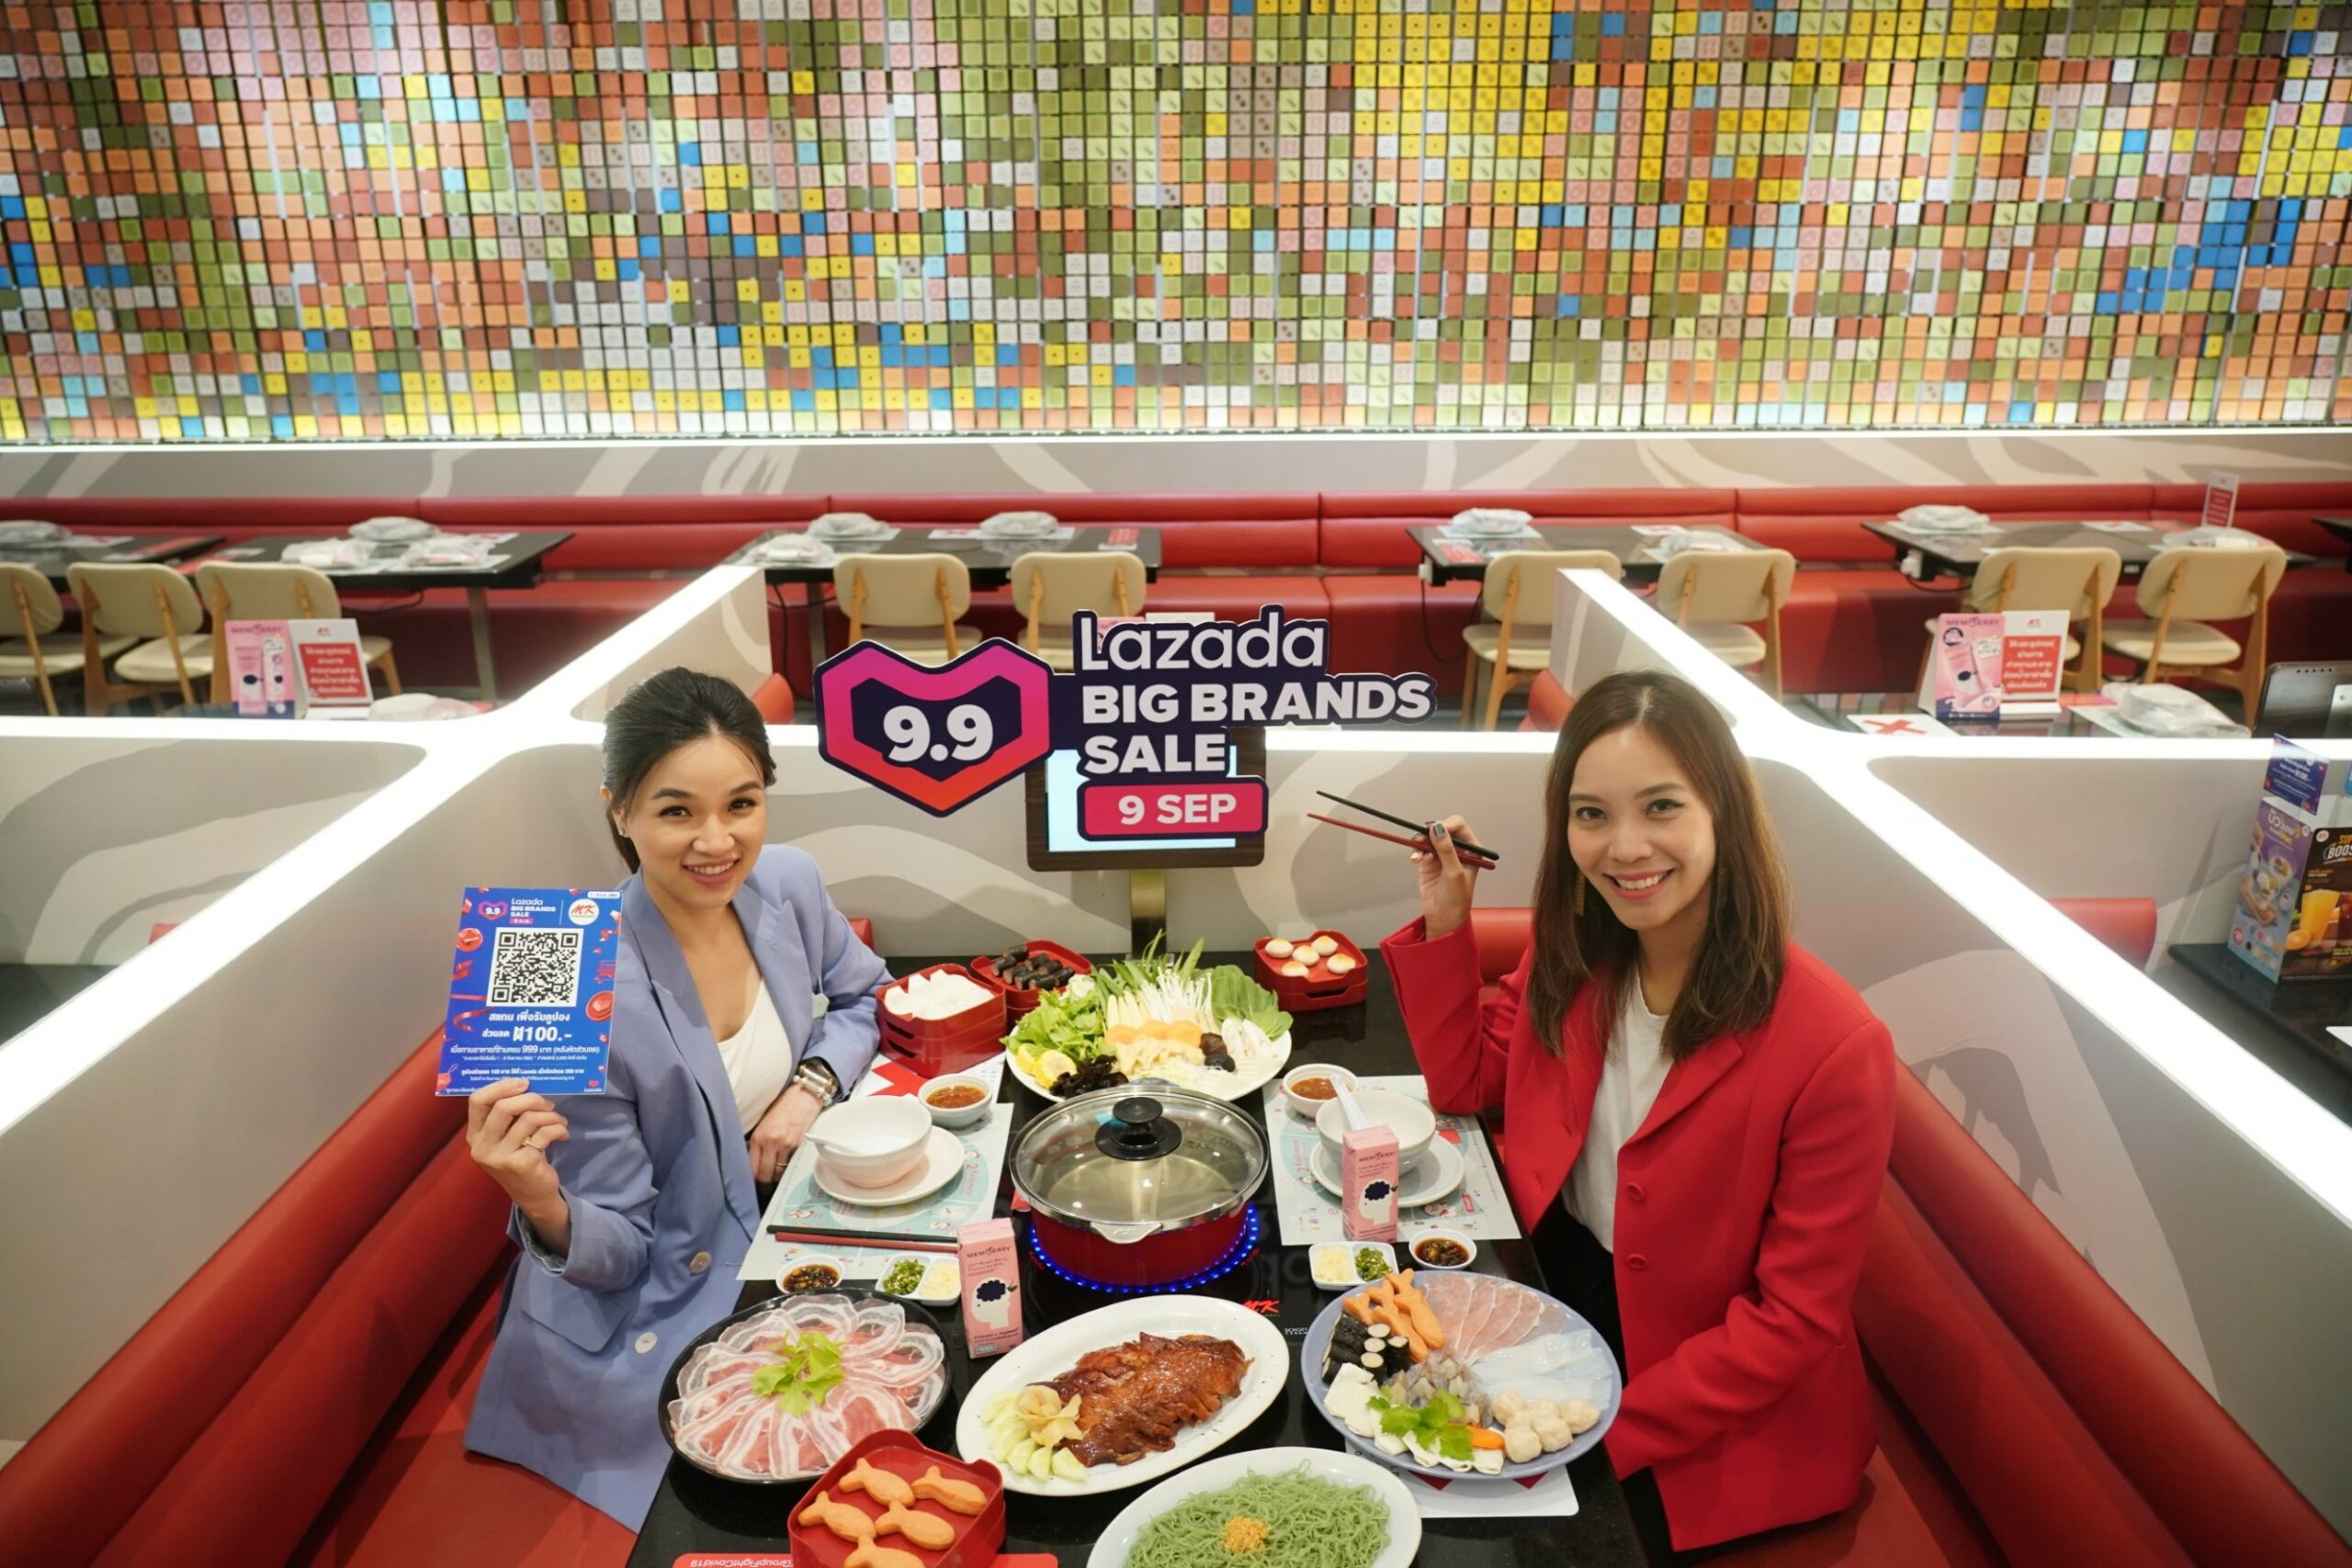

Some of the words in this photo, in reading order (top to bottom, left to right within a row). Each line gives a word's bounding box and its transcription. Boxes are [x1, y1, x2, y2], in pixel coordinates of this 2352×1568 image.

[1081, 612, 1324, 670] Lazada
[1083, 685, 1178, 724] BIG
[1191, 680, 1432, 722] BRANDS
[883, 705, 994, 763] 9.9
[1083, 735, 1225, 774] SALE
[1118, 795, 1145, 826] 9
[1158, 793, 1237, 825] SEP
[485, 907, 501, 916] 9.9
[571, 904, 595, 915] MK
[489, 1013, 514, 1021] สแกน
[516, 1010, 571, 1025] เพื่อรับคูปอง
[482, 1028, 510, 1038] ส่วนลด
[522, 1045, 538, 1054] 999
[1243, 1300, 1280, 1314] MK
[691, 1558, 794, 1568] GroupFightCovid19
